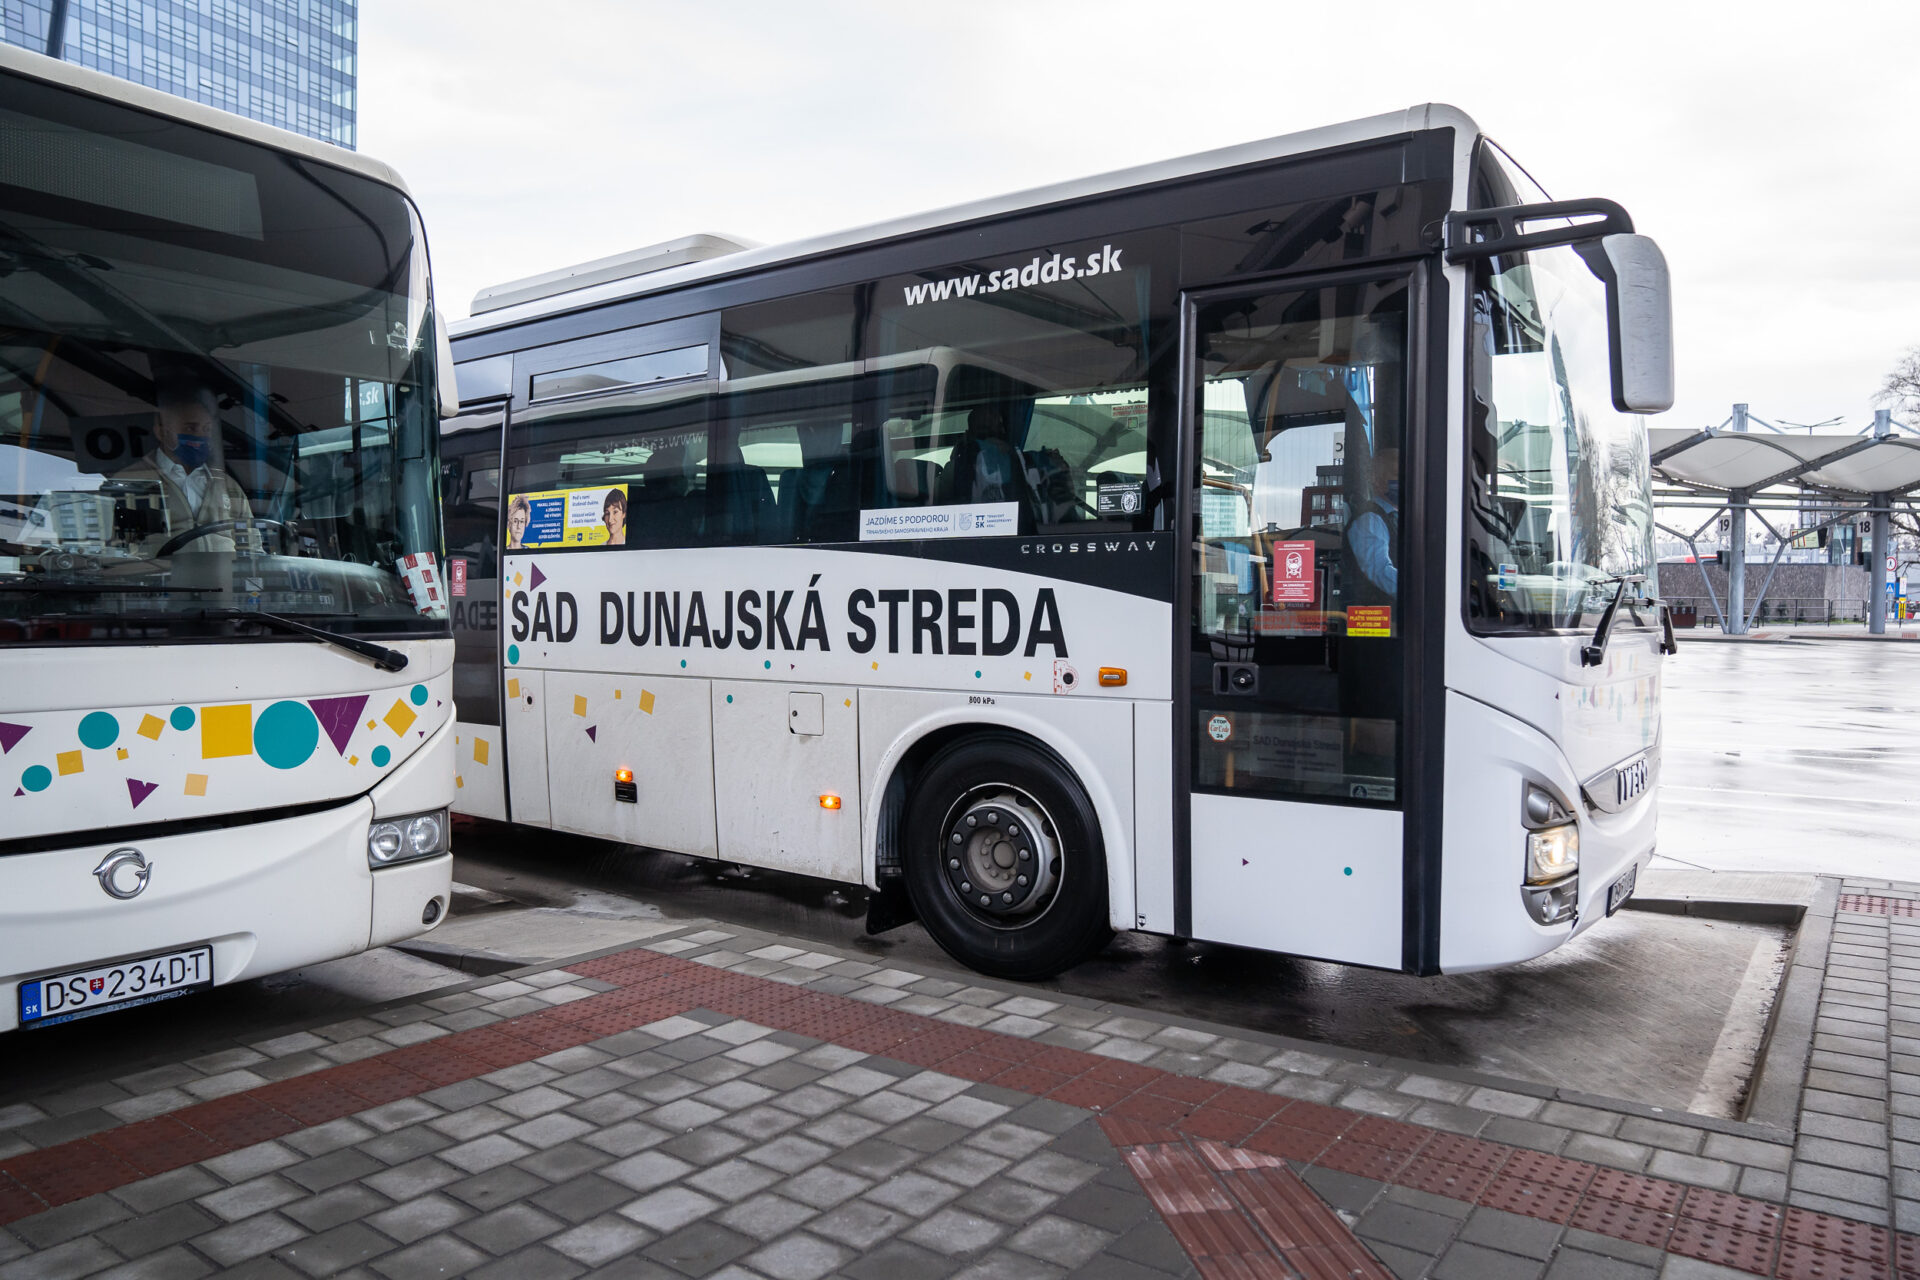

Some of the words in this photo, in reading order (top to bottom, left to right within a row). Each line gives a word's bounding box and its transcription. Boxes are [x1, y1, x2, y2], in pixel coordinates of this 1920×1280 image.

[904, 244, 1123, 306] www.sadds.sk
[865, 515, 897, 526] JAZDÍME
[899, 515, 904, 524] S
[904, 513, 950, 525] PODPOROU
[1719, 518, 1730, 532] 19
[1859, 521, 1871, 533] 18
[1021, 540, 1156, 554] CROSSWAY
[511, 590, 578, 643] SAD
[600, 574, 831, 652] DUNAJSKÁ
[847, 588, 1069, 658] STREDA
[968, 696, 982, 705] 800
[982, 696, 995, 705] kPa
[1253, 735, 1271, 746] SAD
[25, 1003, 38, 1015] SK
